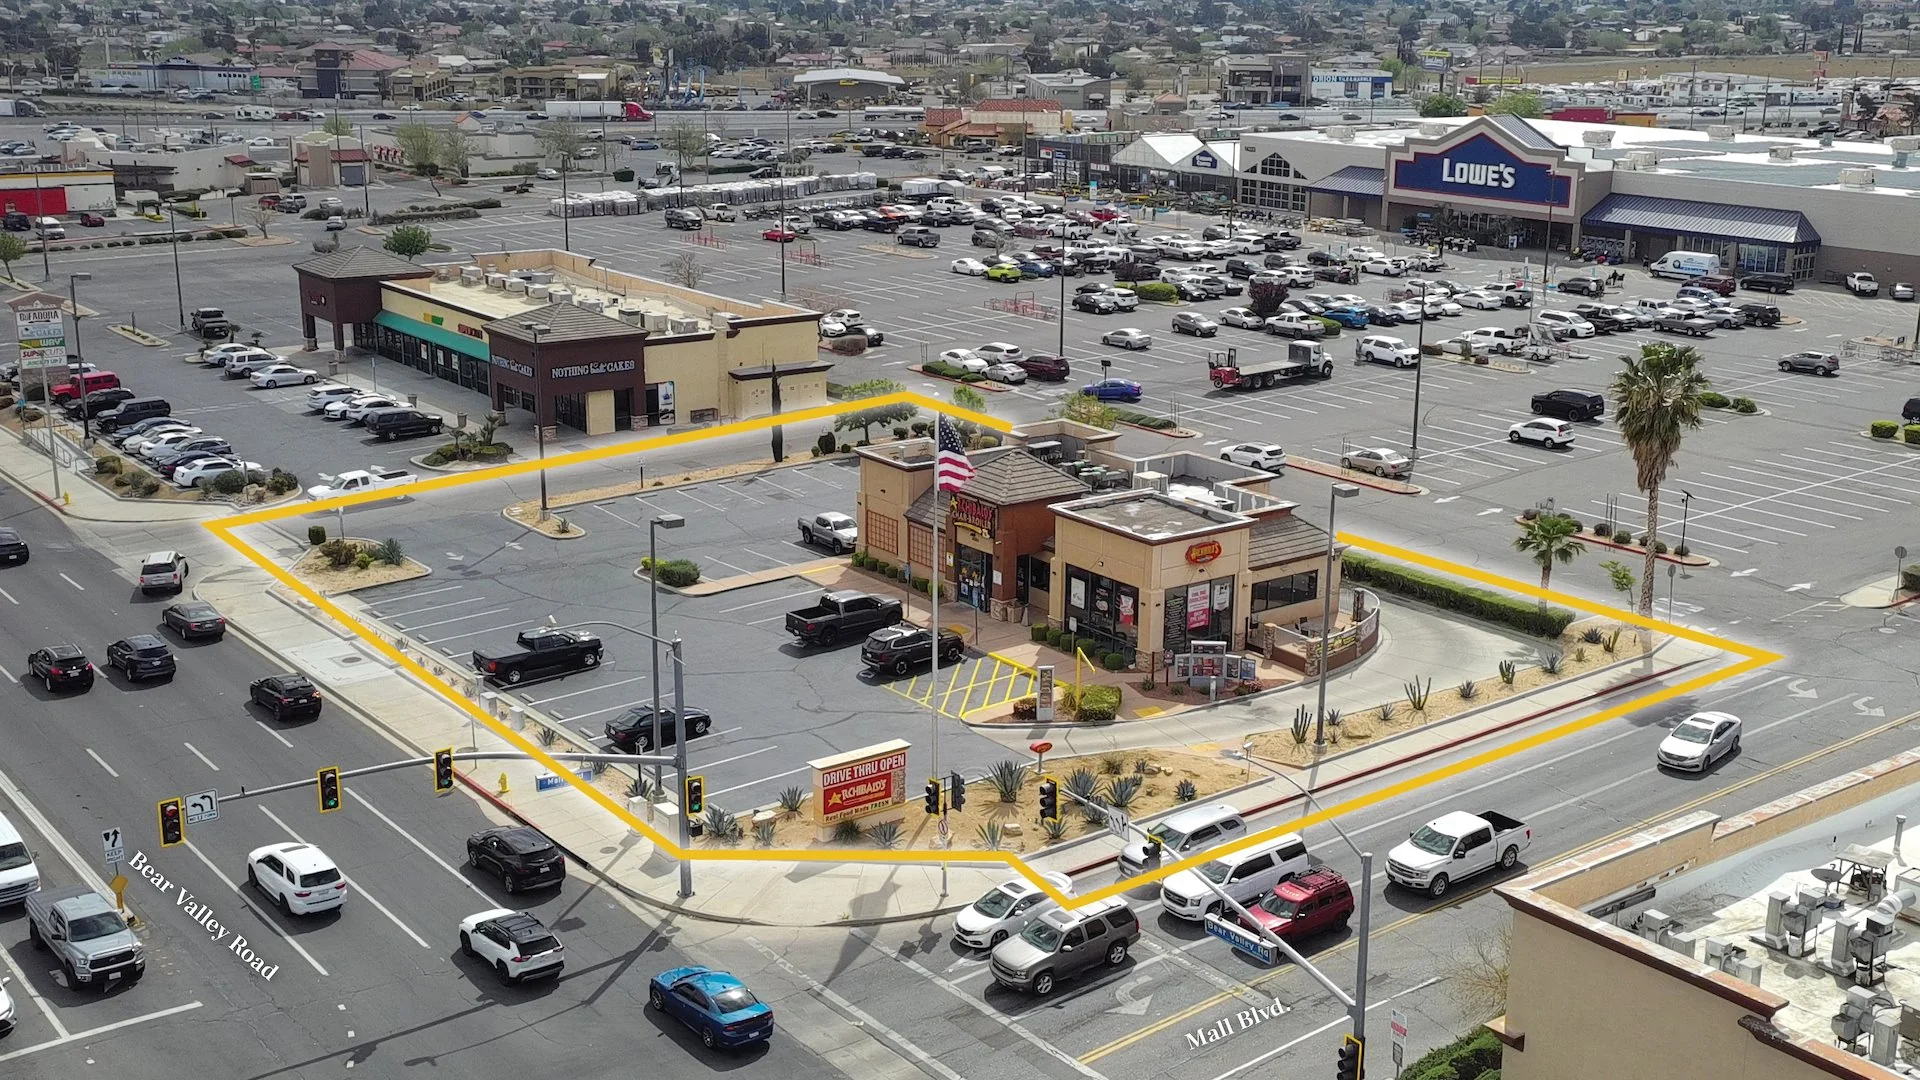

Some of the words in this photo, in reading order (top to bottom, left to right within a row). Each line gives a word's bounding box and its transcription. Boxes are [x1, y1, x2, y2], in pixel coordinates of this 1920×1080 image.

[1442, 158, 1516, 189] LOWE'S
[22, 348, 64, 358] SUPCUTS
[551, 365, 589, 379] NOTHING
[606, 360, 635, 373] CAKES
[823, 768, 852, 786] DRIVE
[853, 761, 878, 779] THRU
[880, 754, 905, 771] OPEN
[1207, 920, 1227, 936] Bear
[1230, 930, 1254, 951] Valley
[1257, 945, 1269, 957] Rd
